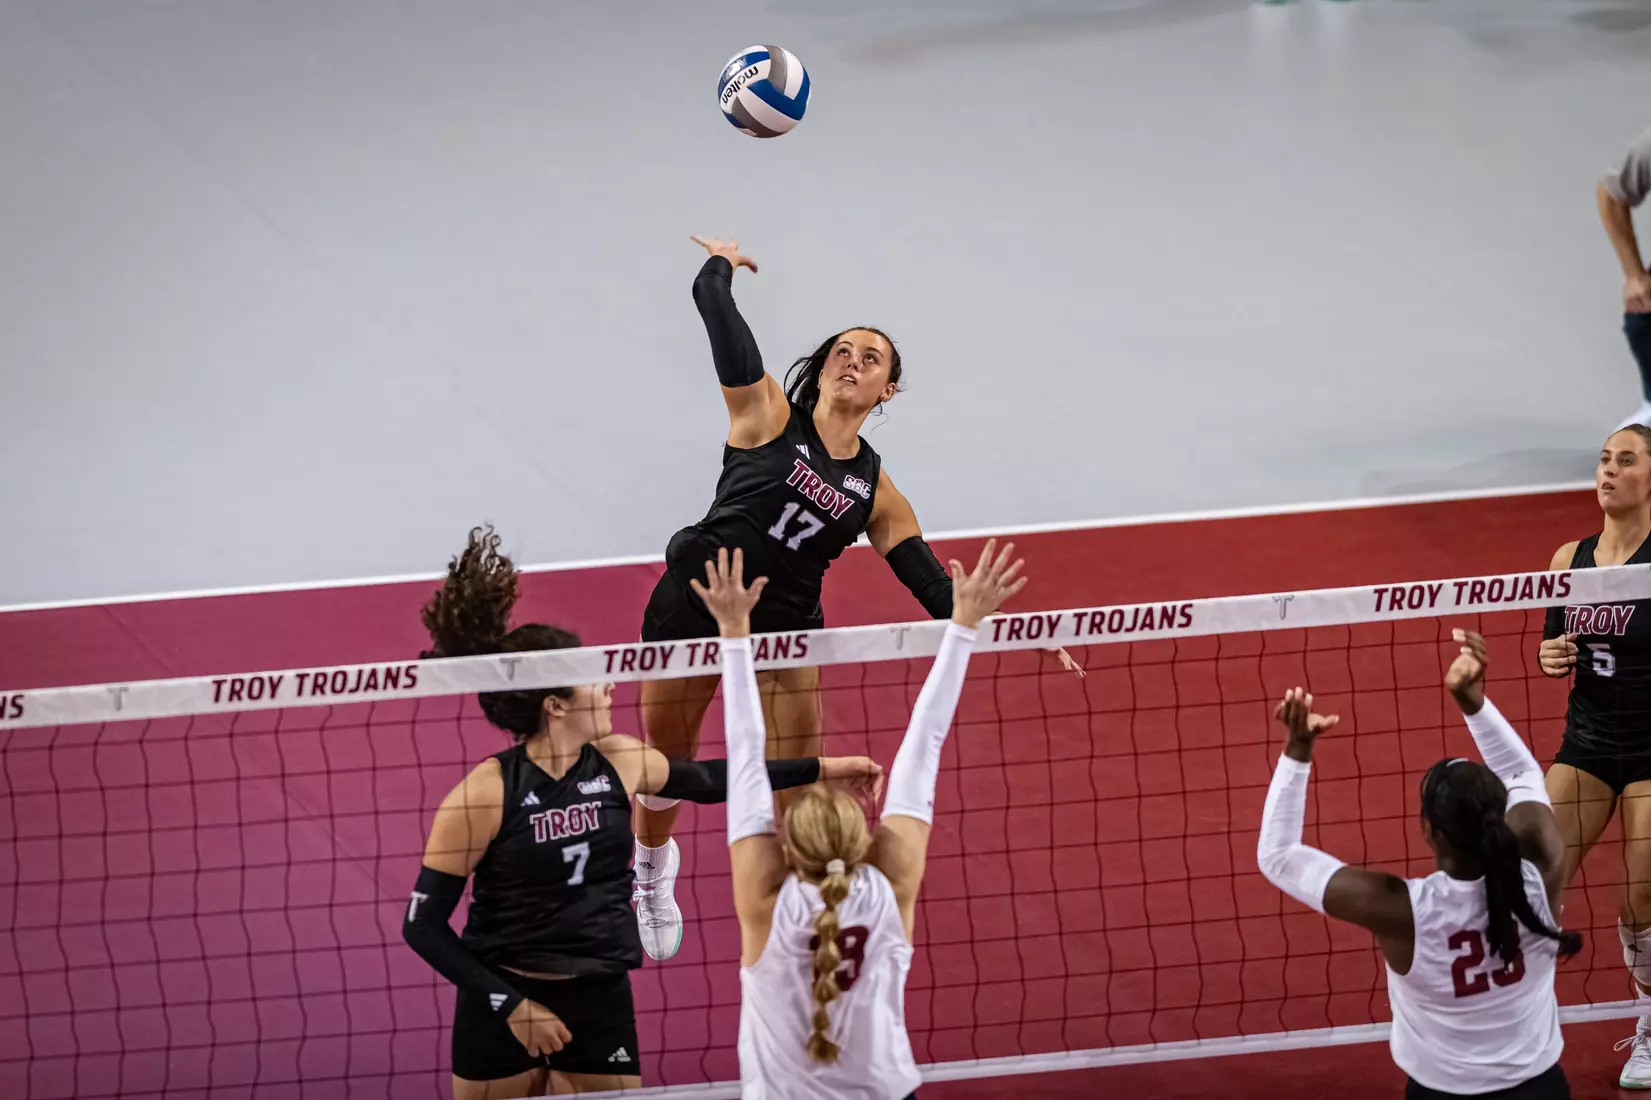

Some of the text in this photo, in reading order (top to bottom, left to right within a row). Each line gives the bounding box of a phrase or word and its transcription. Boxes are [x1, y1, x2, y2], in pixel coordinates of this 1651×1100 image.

[722, 65, 759, 104] molten
[785, 458, 855, 520] TROY
[842, 474, 872, 500] SBC
[767, 501, 826, 552] 17
[1374, 572, 1572, 612] TROY TROJANS
[992, 603, 1194, 642] TROY TROJANS
[1564, 604, 1635, 636] TROY
[603, 633, 809, 674] TROY TRANS
[1586, 643, 1616, 677] 5
[211, 664, 419, 704] TROY TROJANS
[529, 801, 602, 843] TROY
[561, 841, 590, 885] 7
